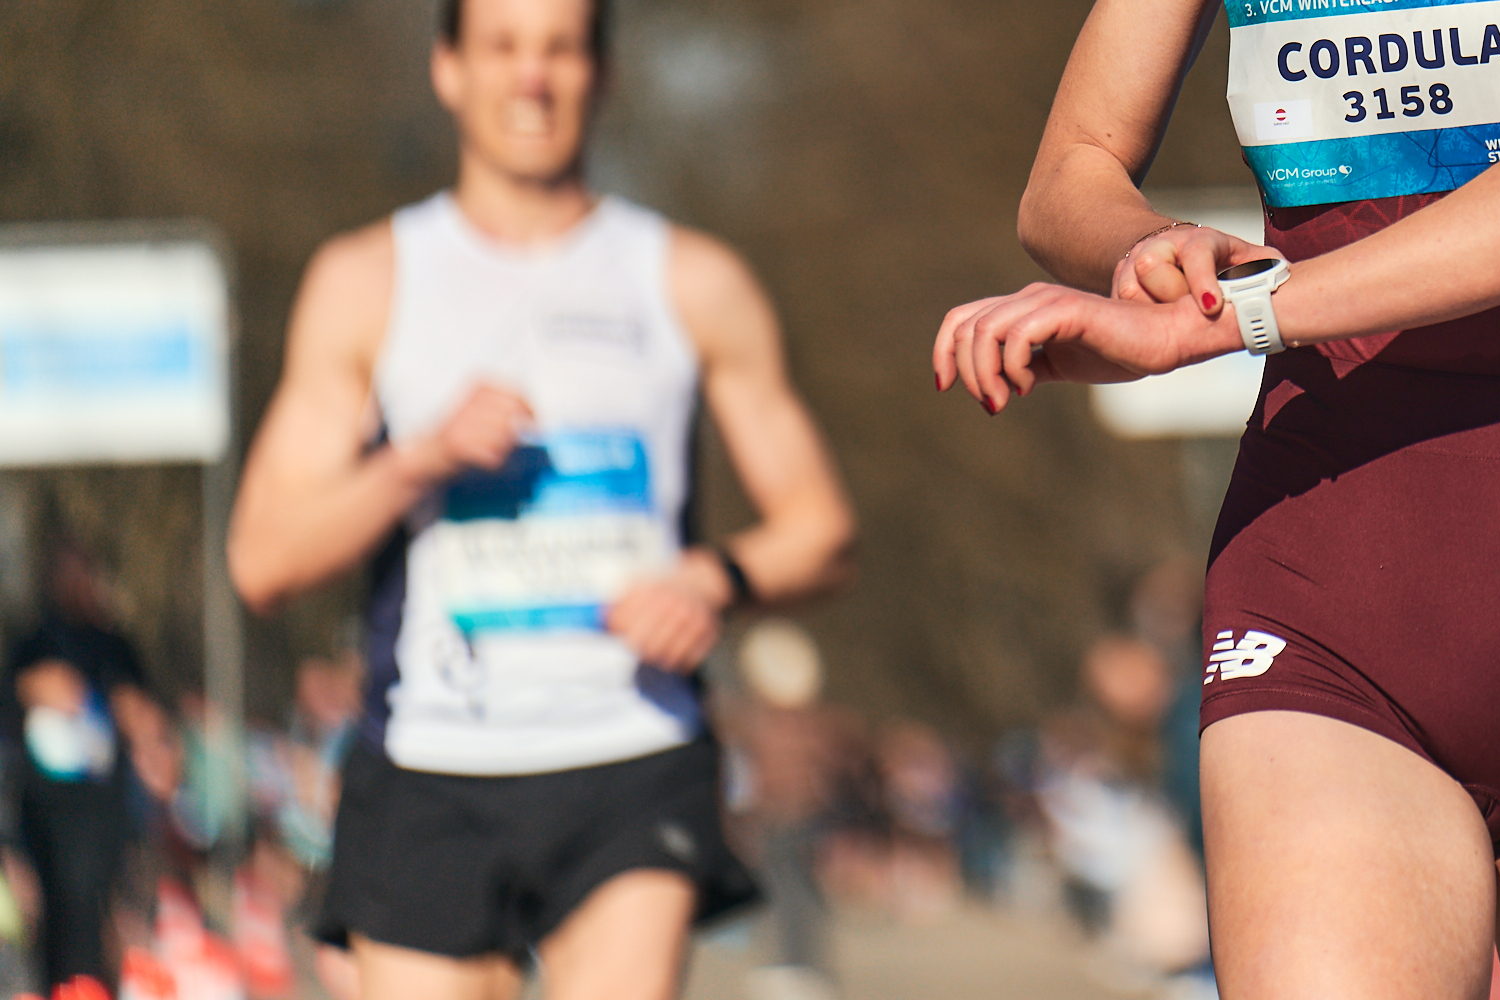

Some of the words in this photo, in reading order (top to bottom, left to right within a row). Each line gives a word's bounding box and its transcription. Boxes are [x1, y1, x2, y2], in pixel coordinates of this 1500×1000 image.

[1244, 3, 1257, 17] 3.
[1342, 83, 1454, 123] 3158
[1266, 167, 1299, 181] VCM
[1301, 167, 1338, 179] Group
